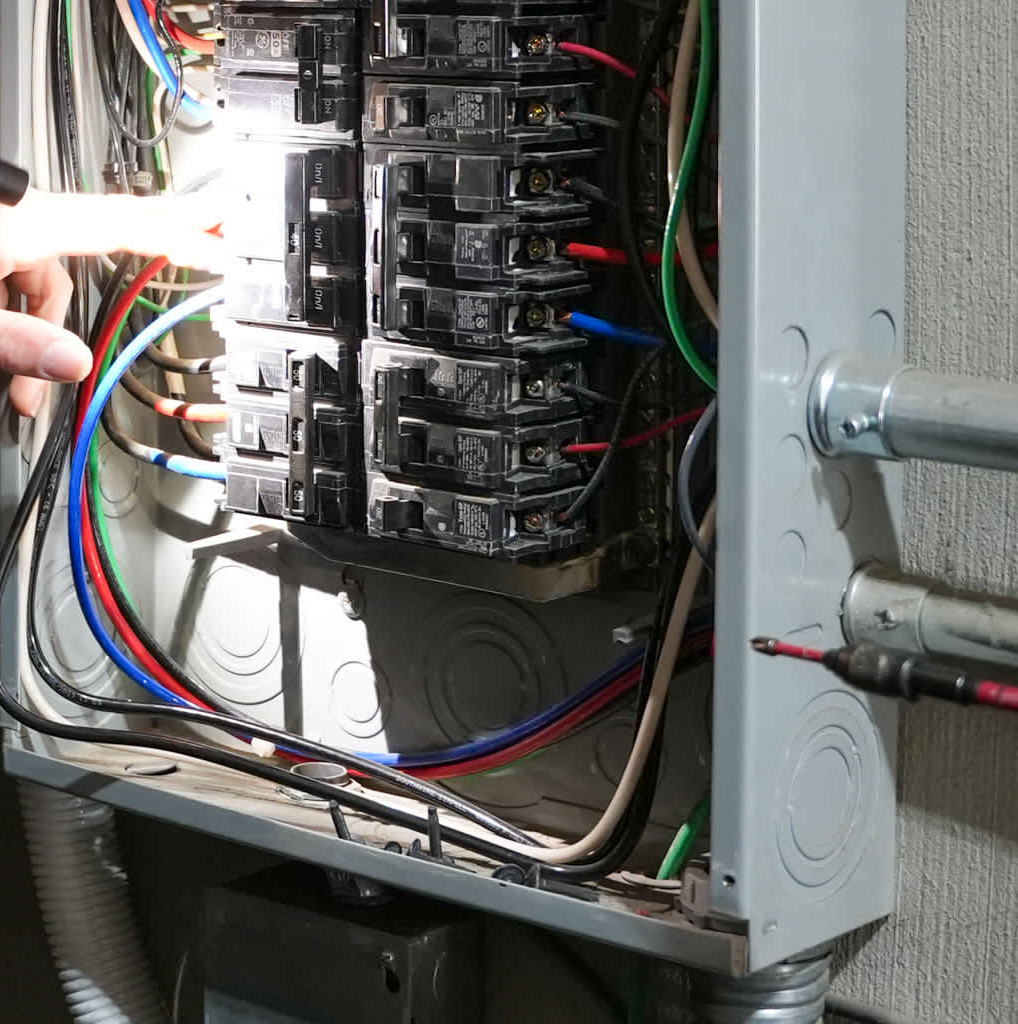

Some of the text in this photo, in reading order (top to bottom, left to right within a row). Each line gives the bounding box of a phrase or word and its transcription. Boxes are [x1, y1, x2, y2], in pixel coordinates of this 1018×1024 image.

[324, 35, 332, 50] ON
[324, 100, 332, 114] ON
[314, 162, 323, 184] On/I
[314, 227, 323, 249] On/I
[314, 289, 323, 310] On/I
[293, 490, 304, 502] 50
